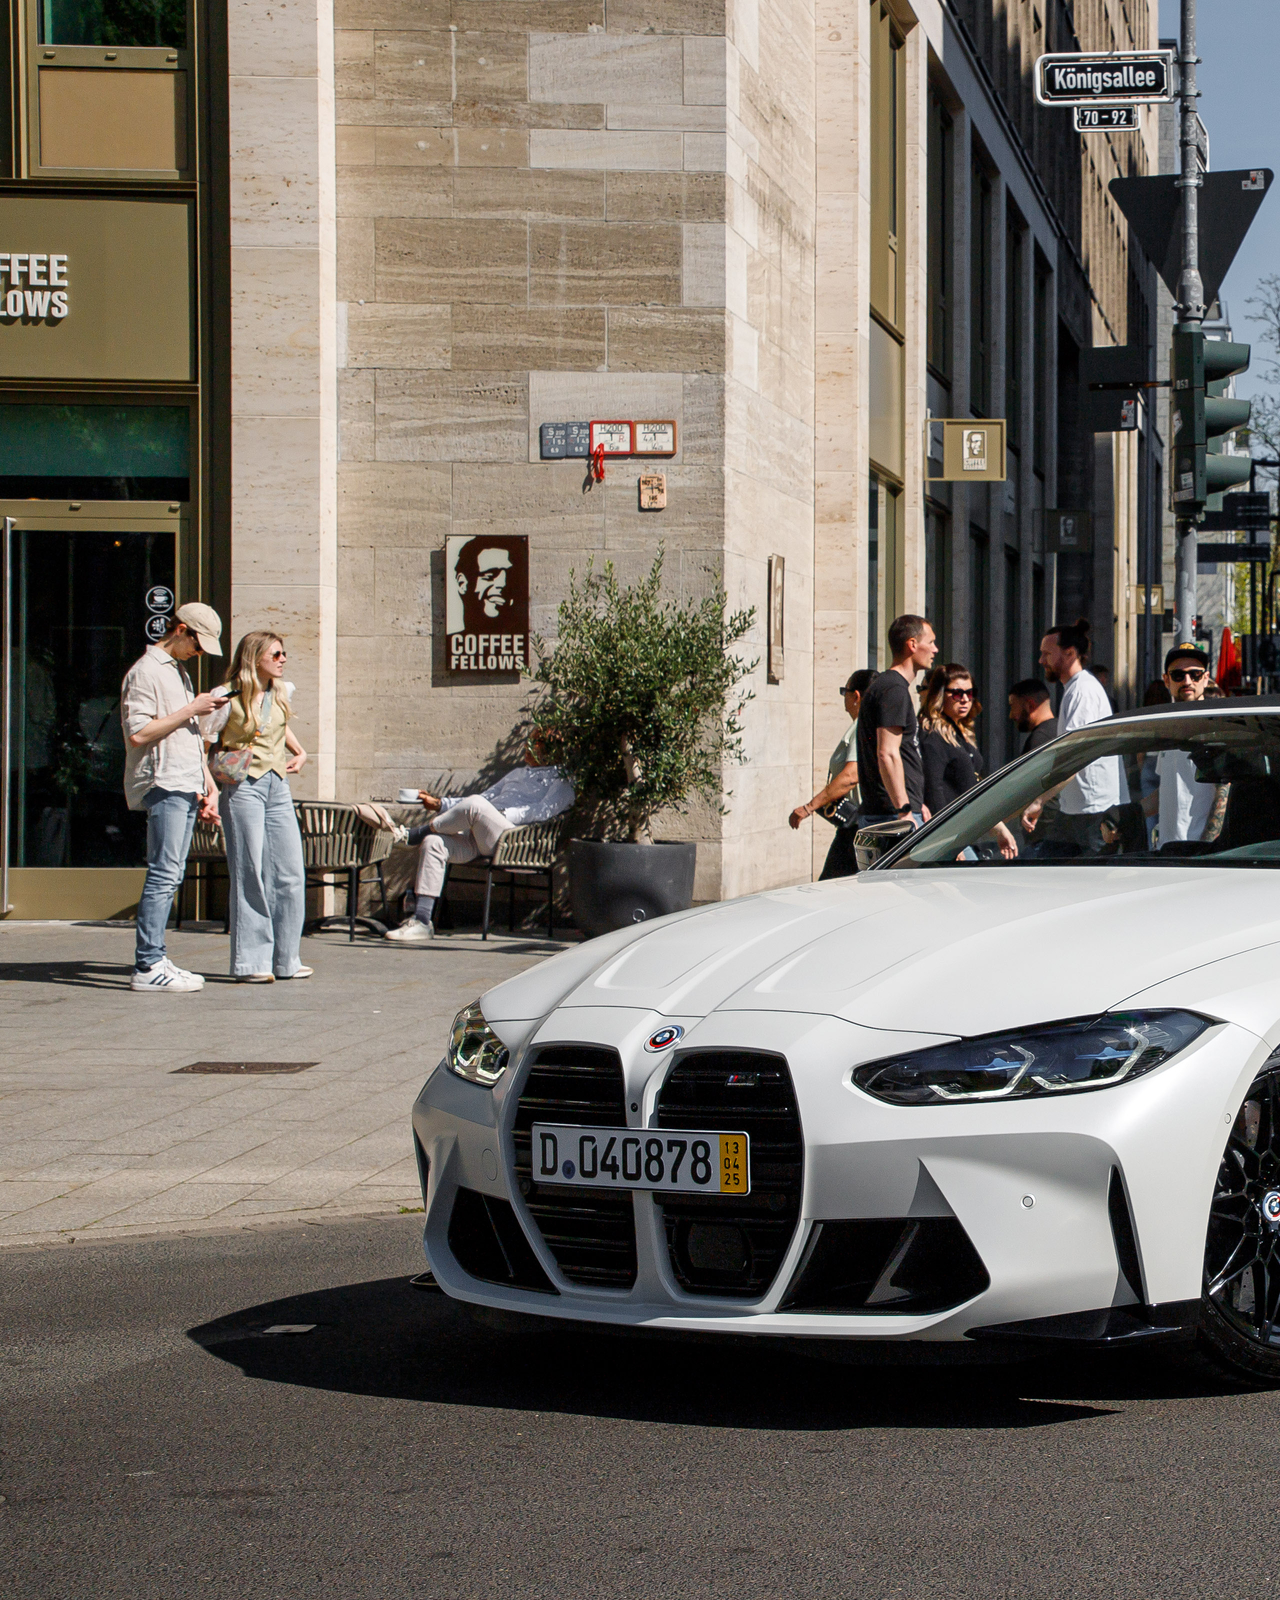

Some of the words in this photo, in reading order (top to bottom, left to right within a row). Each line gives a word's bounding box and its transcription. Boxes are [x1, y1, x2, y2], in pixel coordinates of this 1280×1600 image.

[1054, 65, 1156, 94] Königsallee
[1083, 110, 1099, 125] 70
[1111, 110, 1127, 124] 92
[451, 633, 525, 655] COFFEE
[450, 655, 525, 670] FELLOWS
[723, 1141, 739, 1154] 13
[539, 1132, 558, 1176] D
[578, 1134, 713, 1185] 040878
[723, 1157, 740, 1169] 04
[724, 1172, 741, 1186] 25
